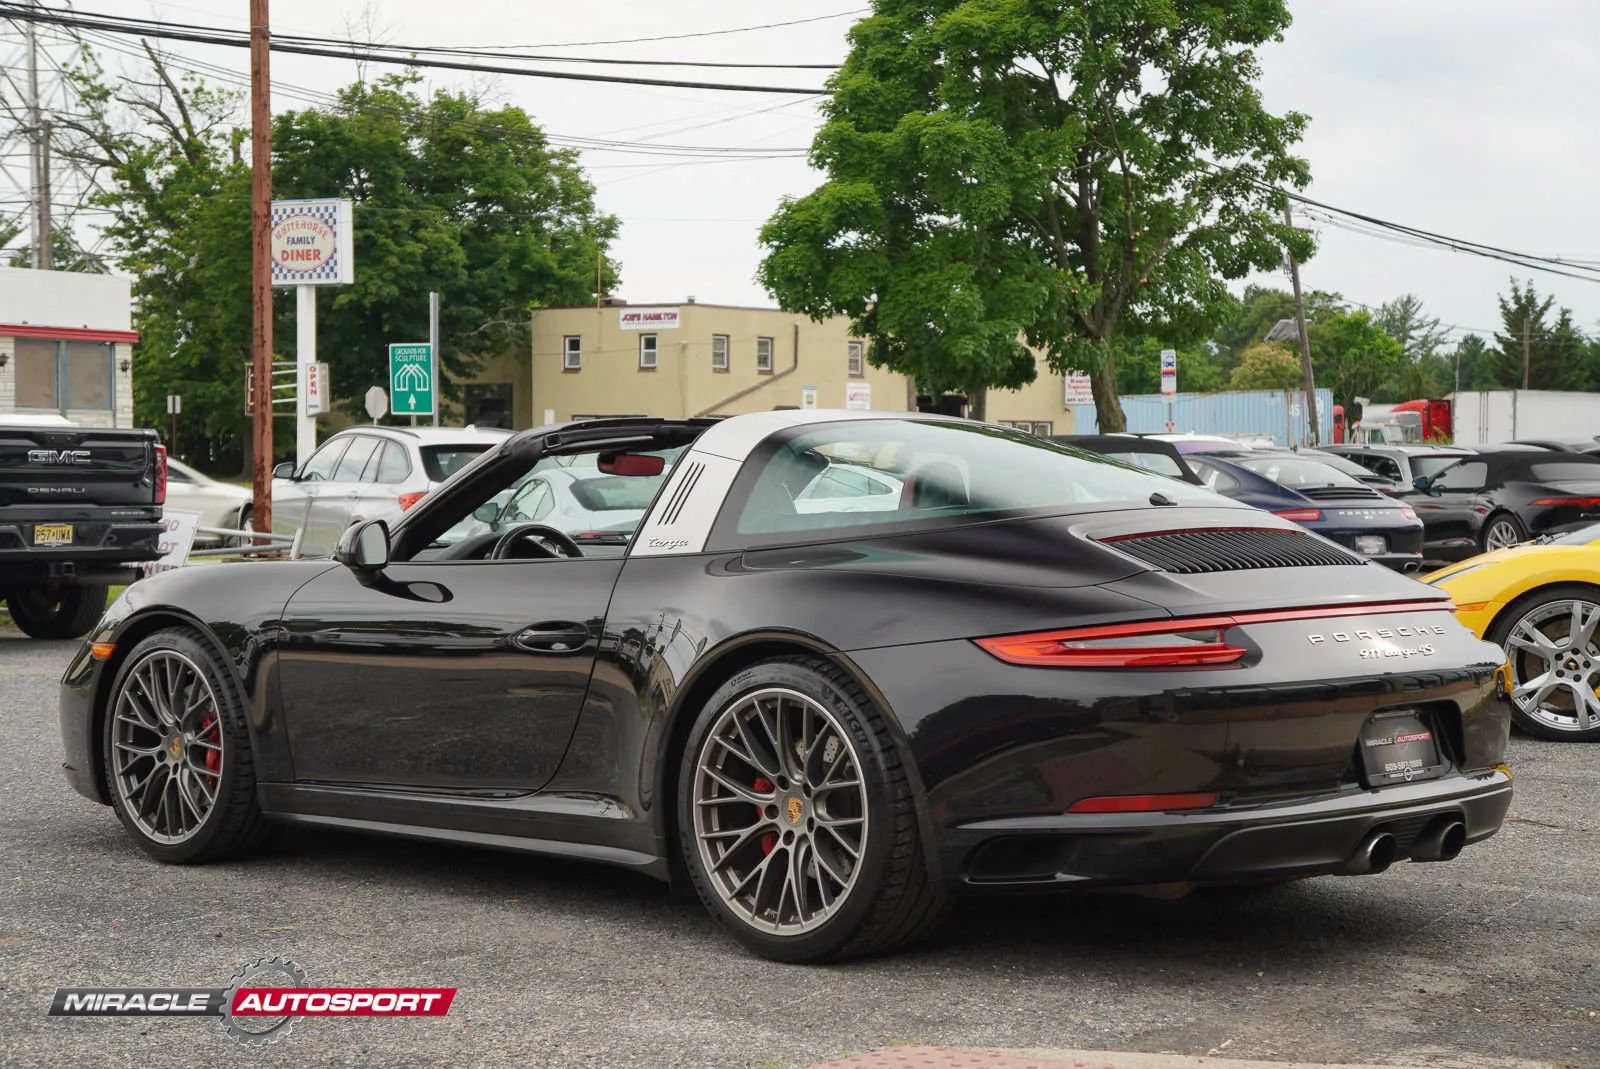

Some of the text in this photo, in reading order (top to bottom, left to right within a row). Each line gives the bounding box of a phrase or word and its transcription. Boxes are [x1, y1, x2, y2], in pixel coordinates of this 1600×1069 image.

[287, 236, 315, 245] FAMILY
[281, 249, 321, 261] DINER
[395, 354, 427, 362] SCULPTURE
[28, 450, 91, 464] GMC
[1307, 625, 1445, 644] PORSCHE
[1359, 649, 1381, 660] 911
[1366, 732, 1431, 747] MIRACLE AUTOSPORT
